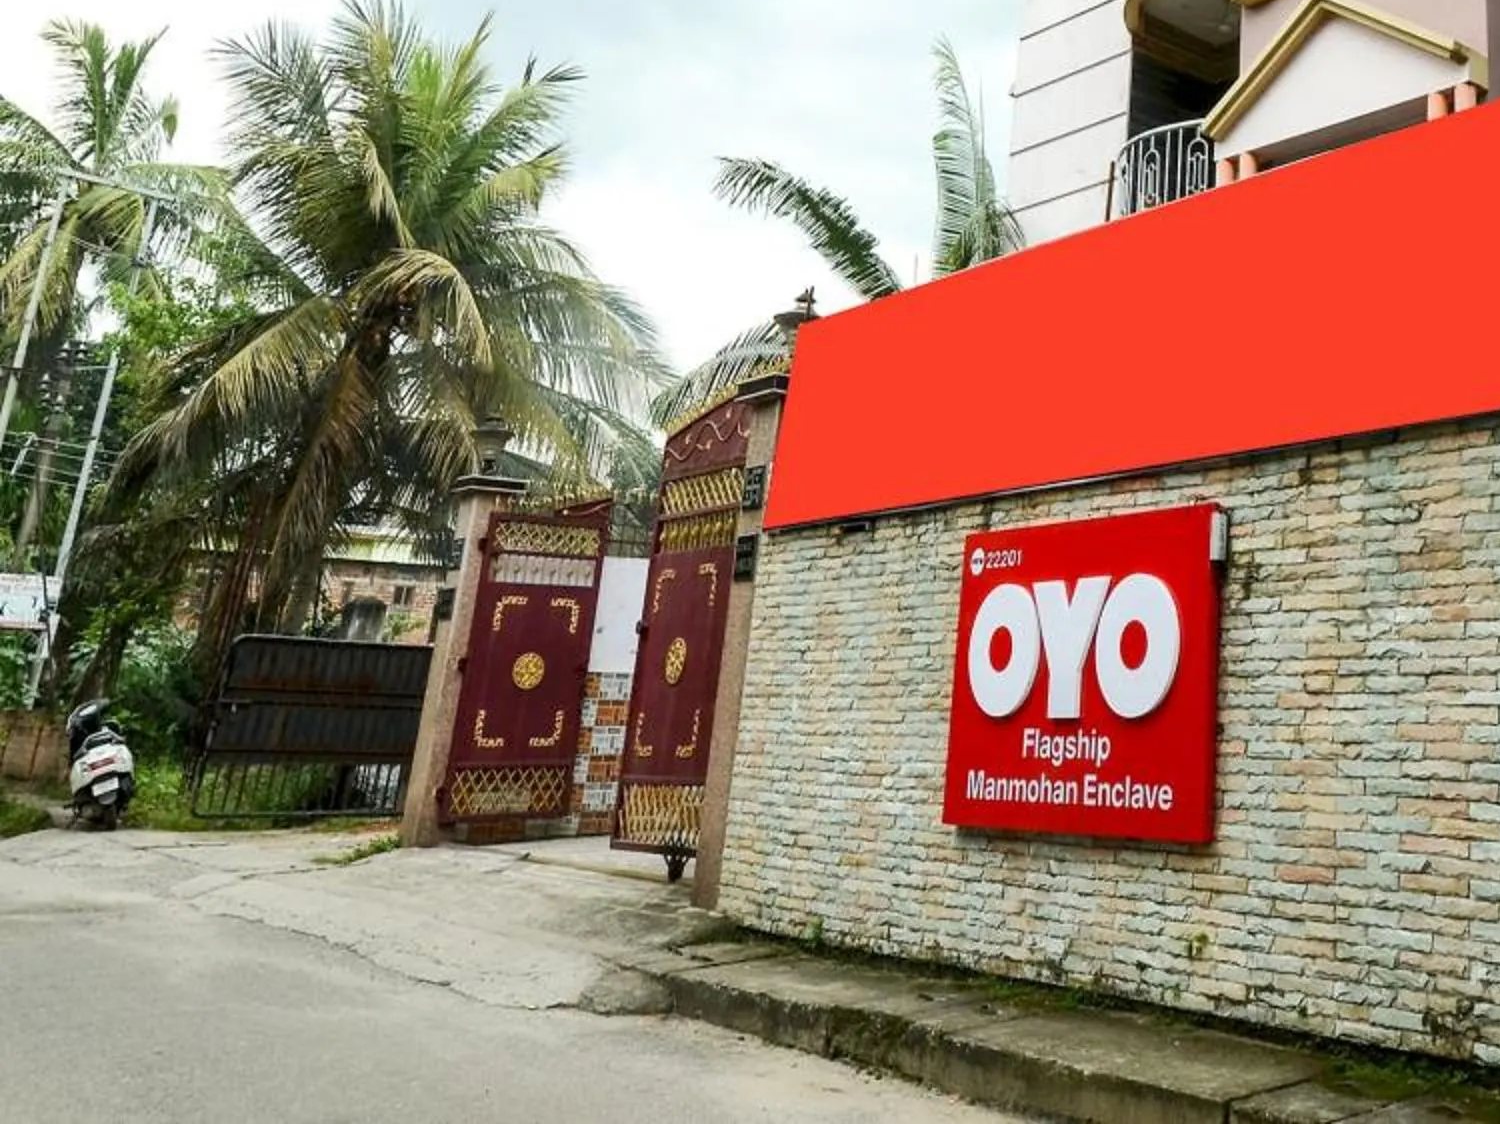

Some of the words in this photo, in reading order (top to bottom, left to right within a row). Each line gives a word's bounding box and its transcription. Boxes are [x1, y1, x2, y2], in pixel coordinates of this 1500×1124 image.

[985, 549, 1022, 568] 22201
[968, 573, 1181, 719] OYO
[1022, 728, 1110, 767] Flagship
[967, 770, 1078, 805] Manmohan
[1083, 775, 1173, 810] Enclave
